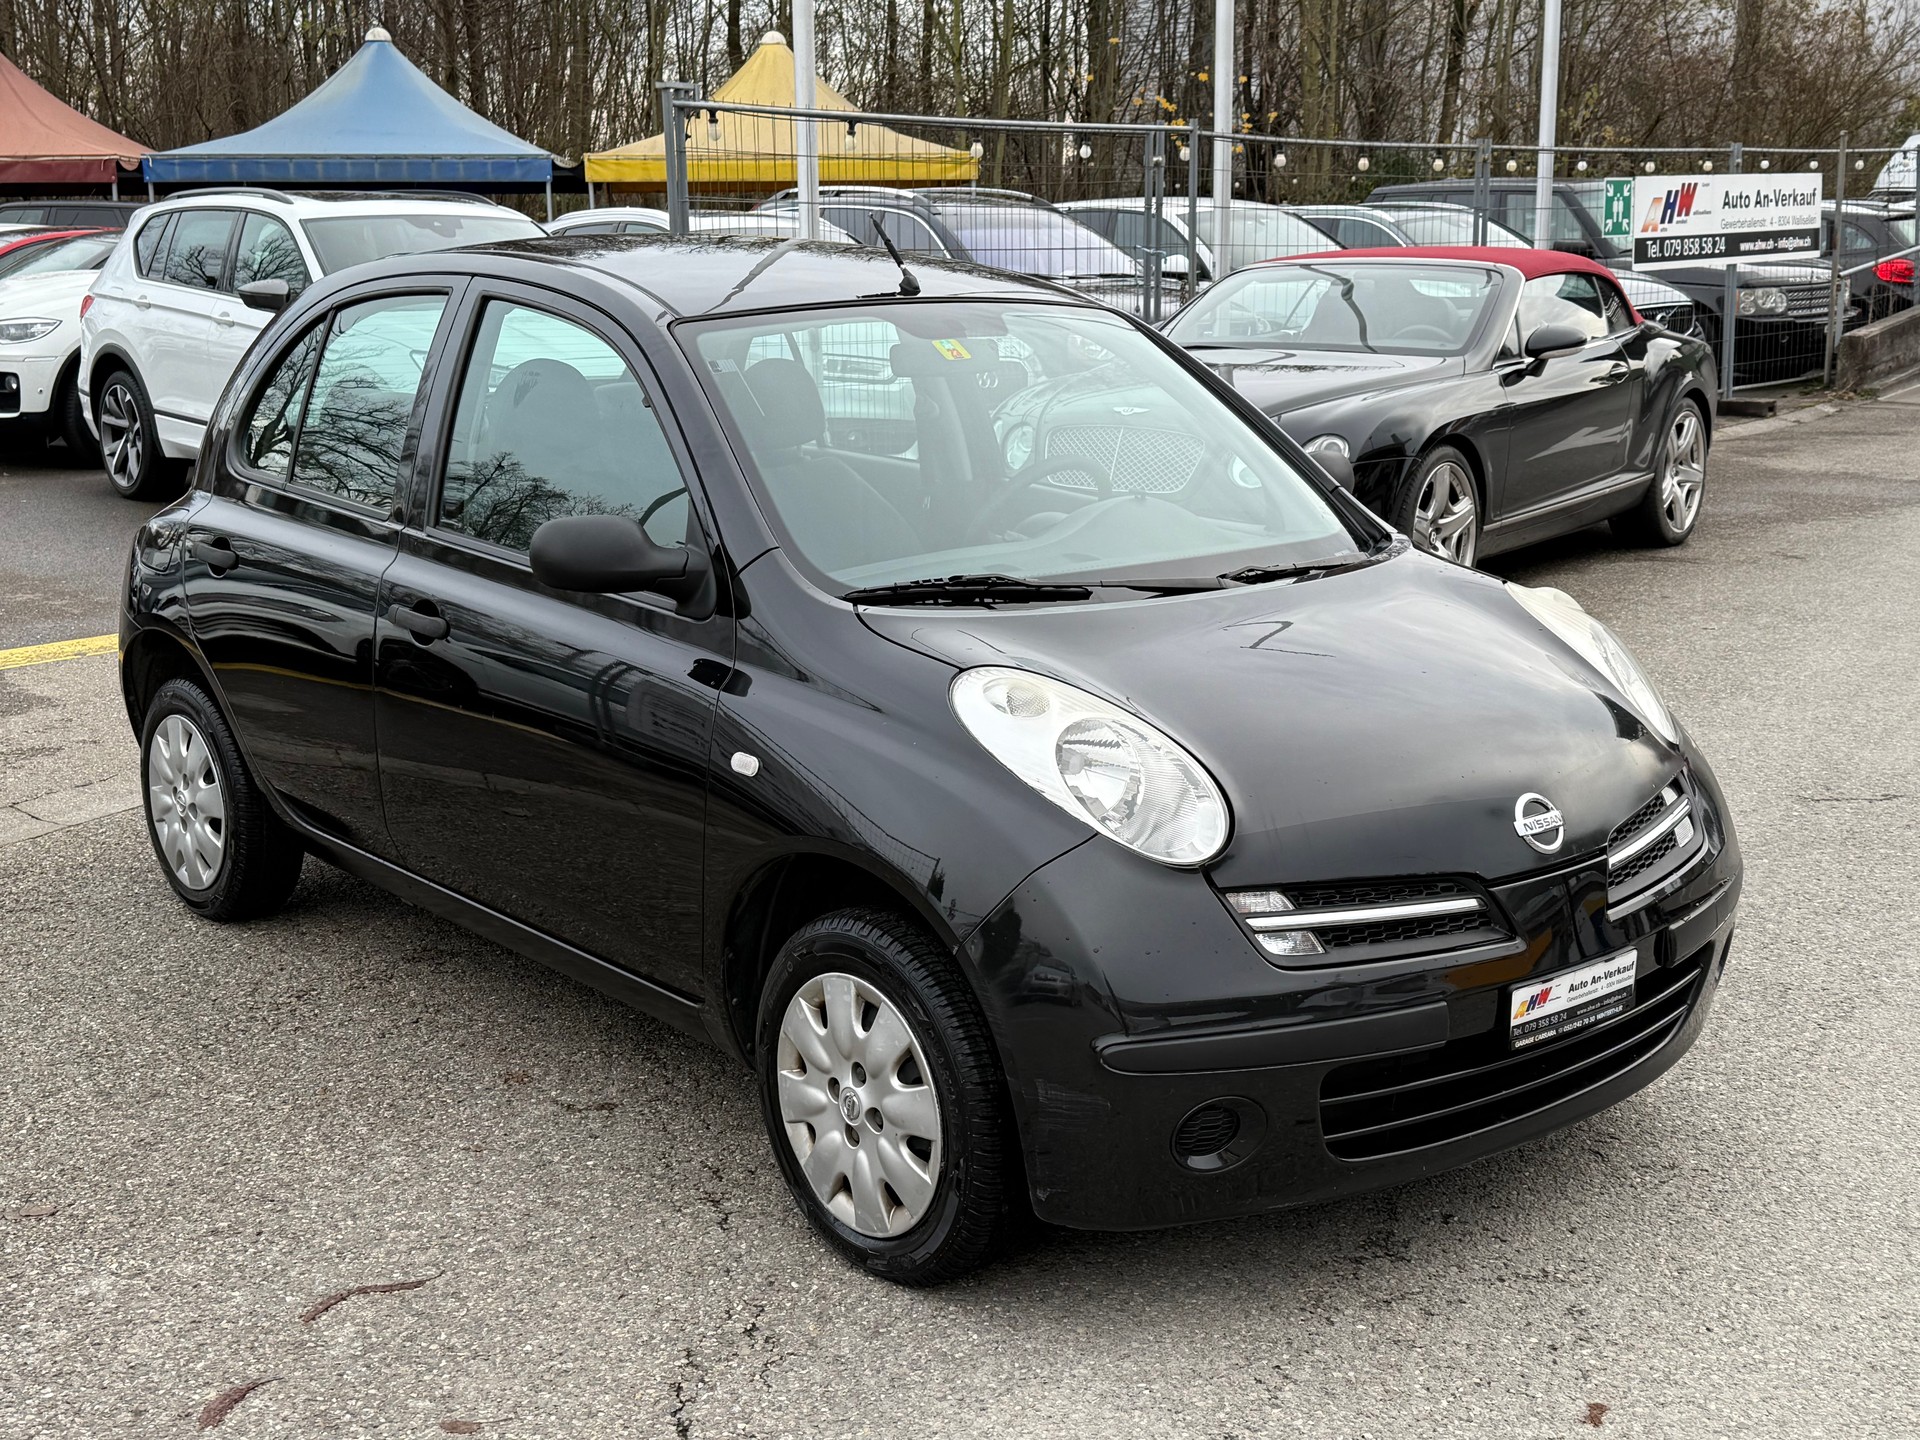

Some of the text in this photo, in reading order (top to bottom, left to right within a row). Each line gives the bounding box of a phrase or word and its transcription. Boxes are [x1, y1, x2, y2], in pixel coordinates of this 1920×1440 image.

[1641, 182, 1698, 232] AHW
[1722, 188, 1817, 210] Auto An-Verkauf
[1770, 216, 1774, 226] 4
[1778, 216, 1790, 226] 8304
[1646, 240, 1662, 258] Tel.
[1664, 239, 1682, 256] 079
[1702, 237, 1713, 254] 58
[1715, 236, 1726, 253] 24
[1740, 238, 1774, 252] www.ahw.ch
[1778, 236, 1811, 250] info@ahw.ch
[1523, 814, 1562, 832] NISSAN
[1568, 960, 1635, 993] Auto An-Verkauf
[1513, 986, 1553, 1020] AHW
[1513, 1012, 1567, 1036] Tel. 079 358 58 24
[1515, 1036, 1534, 1048] GARAGE
